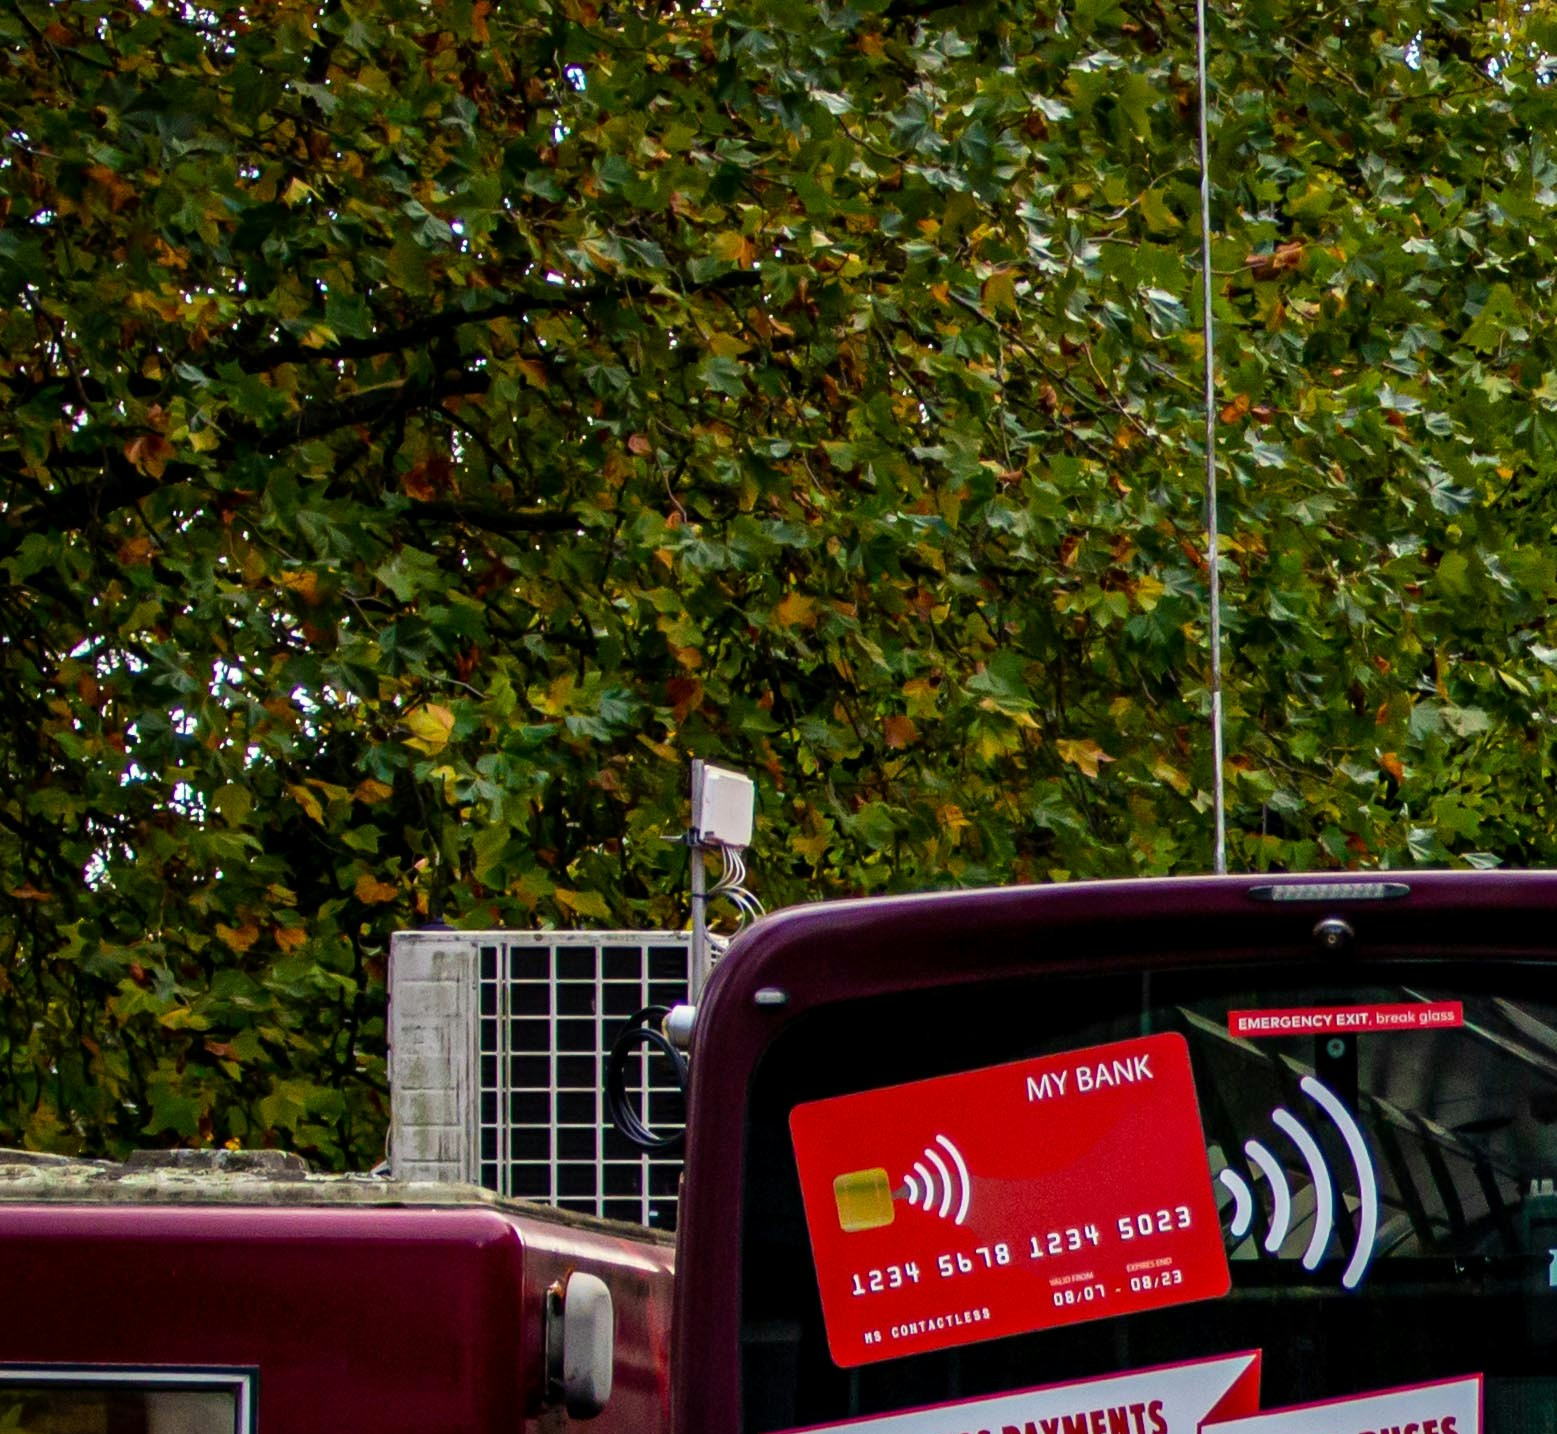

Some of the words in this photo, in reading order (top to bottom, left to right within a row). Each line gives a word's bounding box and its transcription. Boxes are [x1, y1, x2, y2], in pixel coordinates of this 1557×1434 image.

[1238, 1013, 1332, 1031] EMERGENCY
[1336, 1012, 1372, 1028] EXIT,
[1375, 1010, 1416, 1025] break
[1419, 1009, 1455, 1026] glass
[1026, 1071, 1068, 1102] MY
[1075, 1054, 1154, 1093] BANK
[851, 1261, 921, 1296] 1234
[937, 1242, 1012, 1278] 5678
[1029, 1224, 1100, 1259] 1234
[1117, 1206, 1193, 1240] 5023
[1126, 1259, 1155, 1274] EXPIRES
[1156, 1256, 1173, 1269] END
[1049, 1273, 1071, 1287] VALID
[1071, 1270, 1095, 1285] FROM
[1053, 1283, 1106, 1307] 08/07
[1130, 1269, 1184, 1293] 08/23
[891, 1306, 992, 1340] CONTACTLESS
